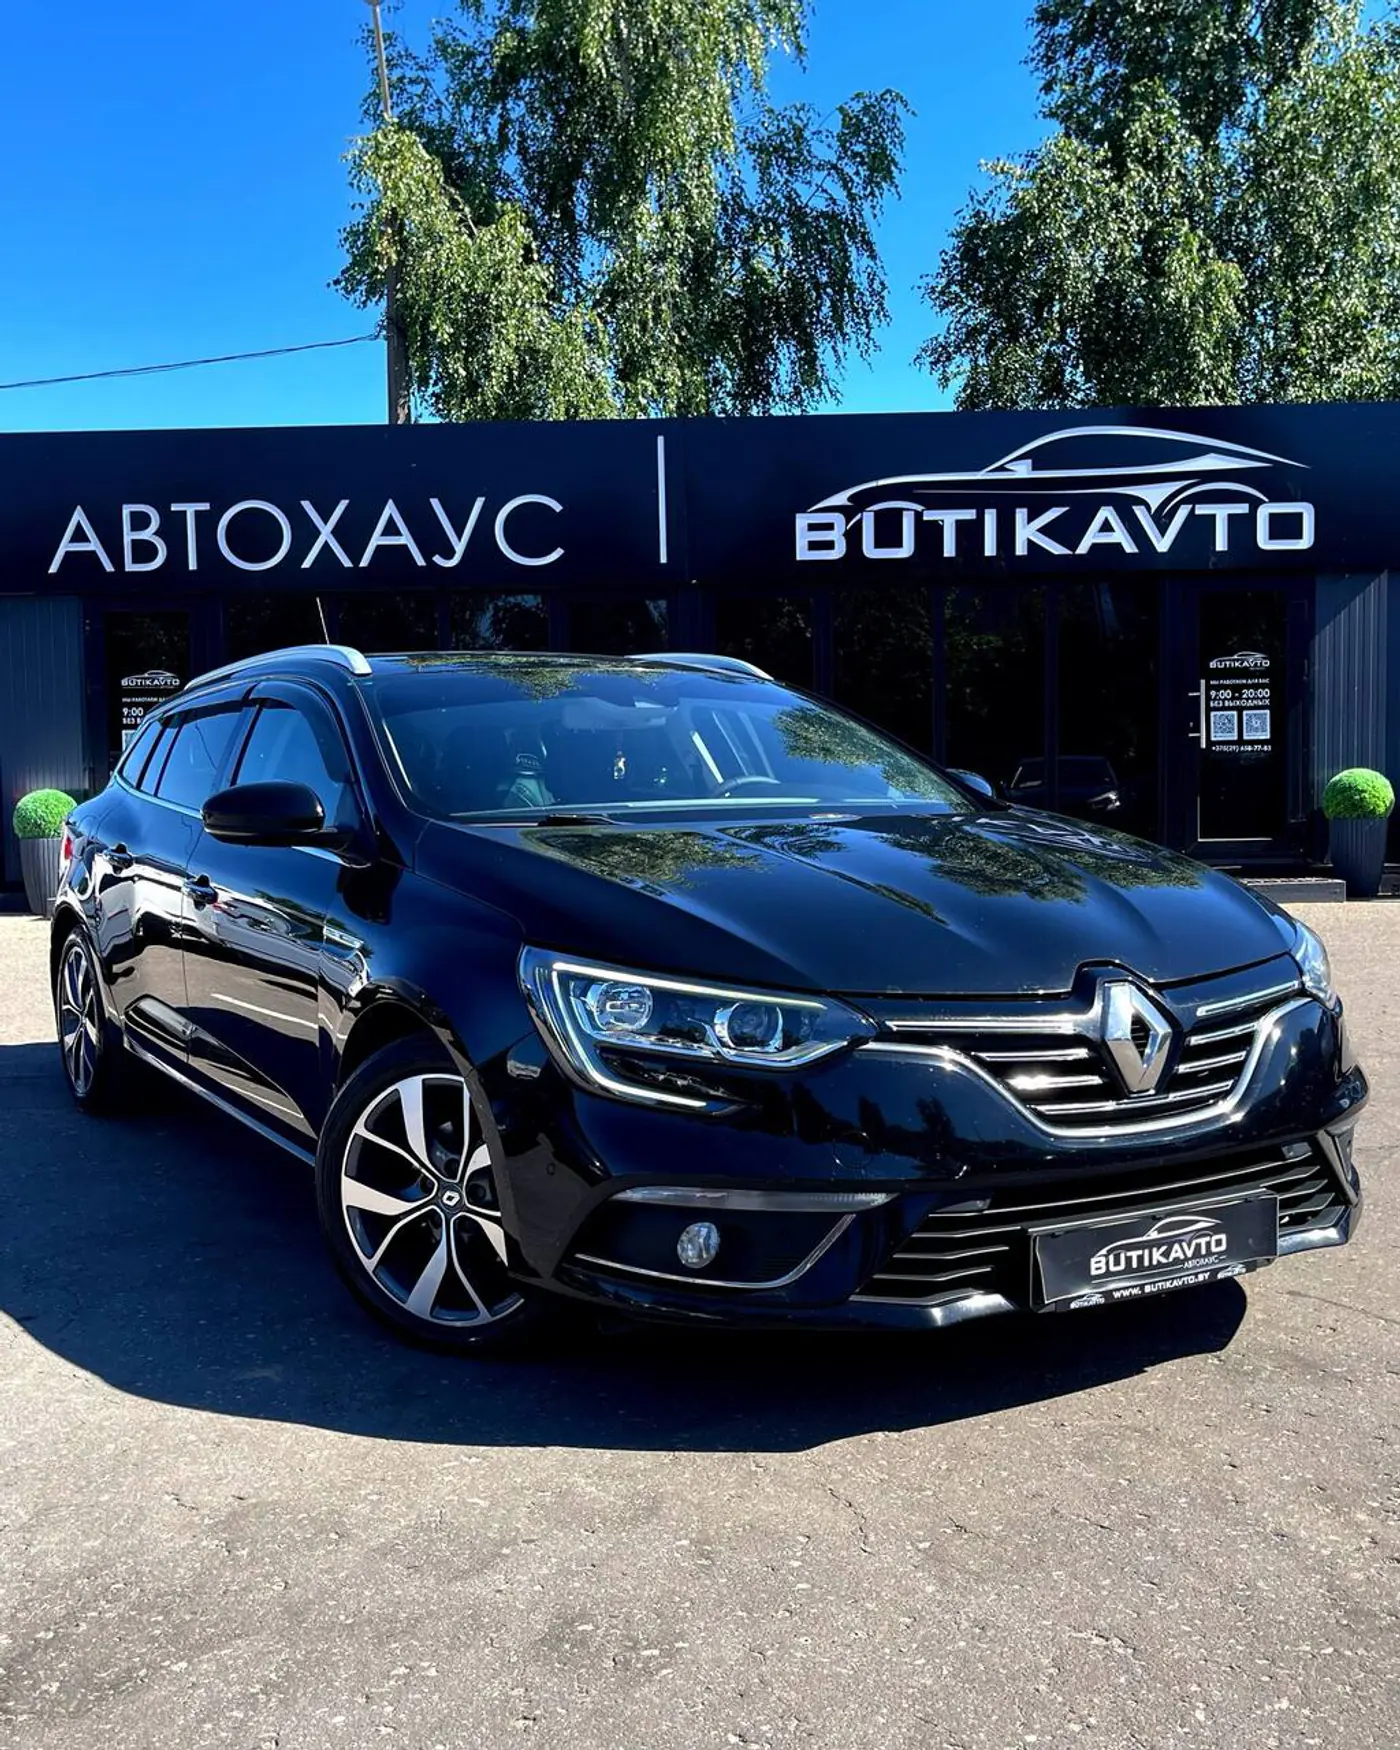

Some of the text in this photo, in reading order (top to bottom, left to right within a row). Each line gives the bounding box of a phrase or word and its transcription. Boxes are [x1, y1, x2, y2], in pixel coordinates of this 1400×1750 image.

[48, 494, 566, 574] АВТОХАУС
[795, 500, 1316, 561] BUTIKAVTO
[1209, 660, 1270, 668] BUTIKAVTO
[1210, 690, 1232, 699] 9:00
[1241, 688, 1270, 698] 20:00
[122, 707, 144, 716] 9:00
[1090, 1233, 1227, 1276] BUTIKAVTO
[1112, 1272, 1210, 1299] WWW. BUTIKAVTO.BY
